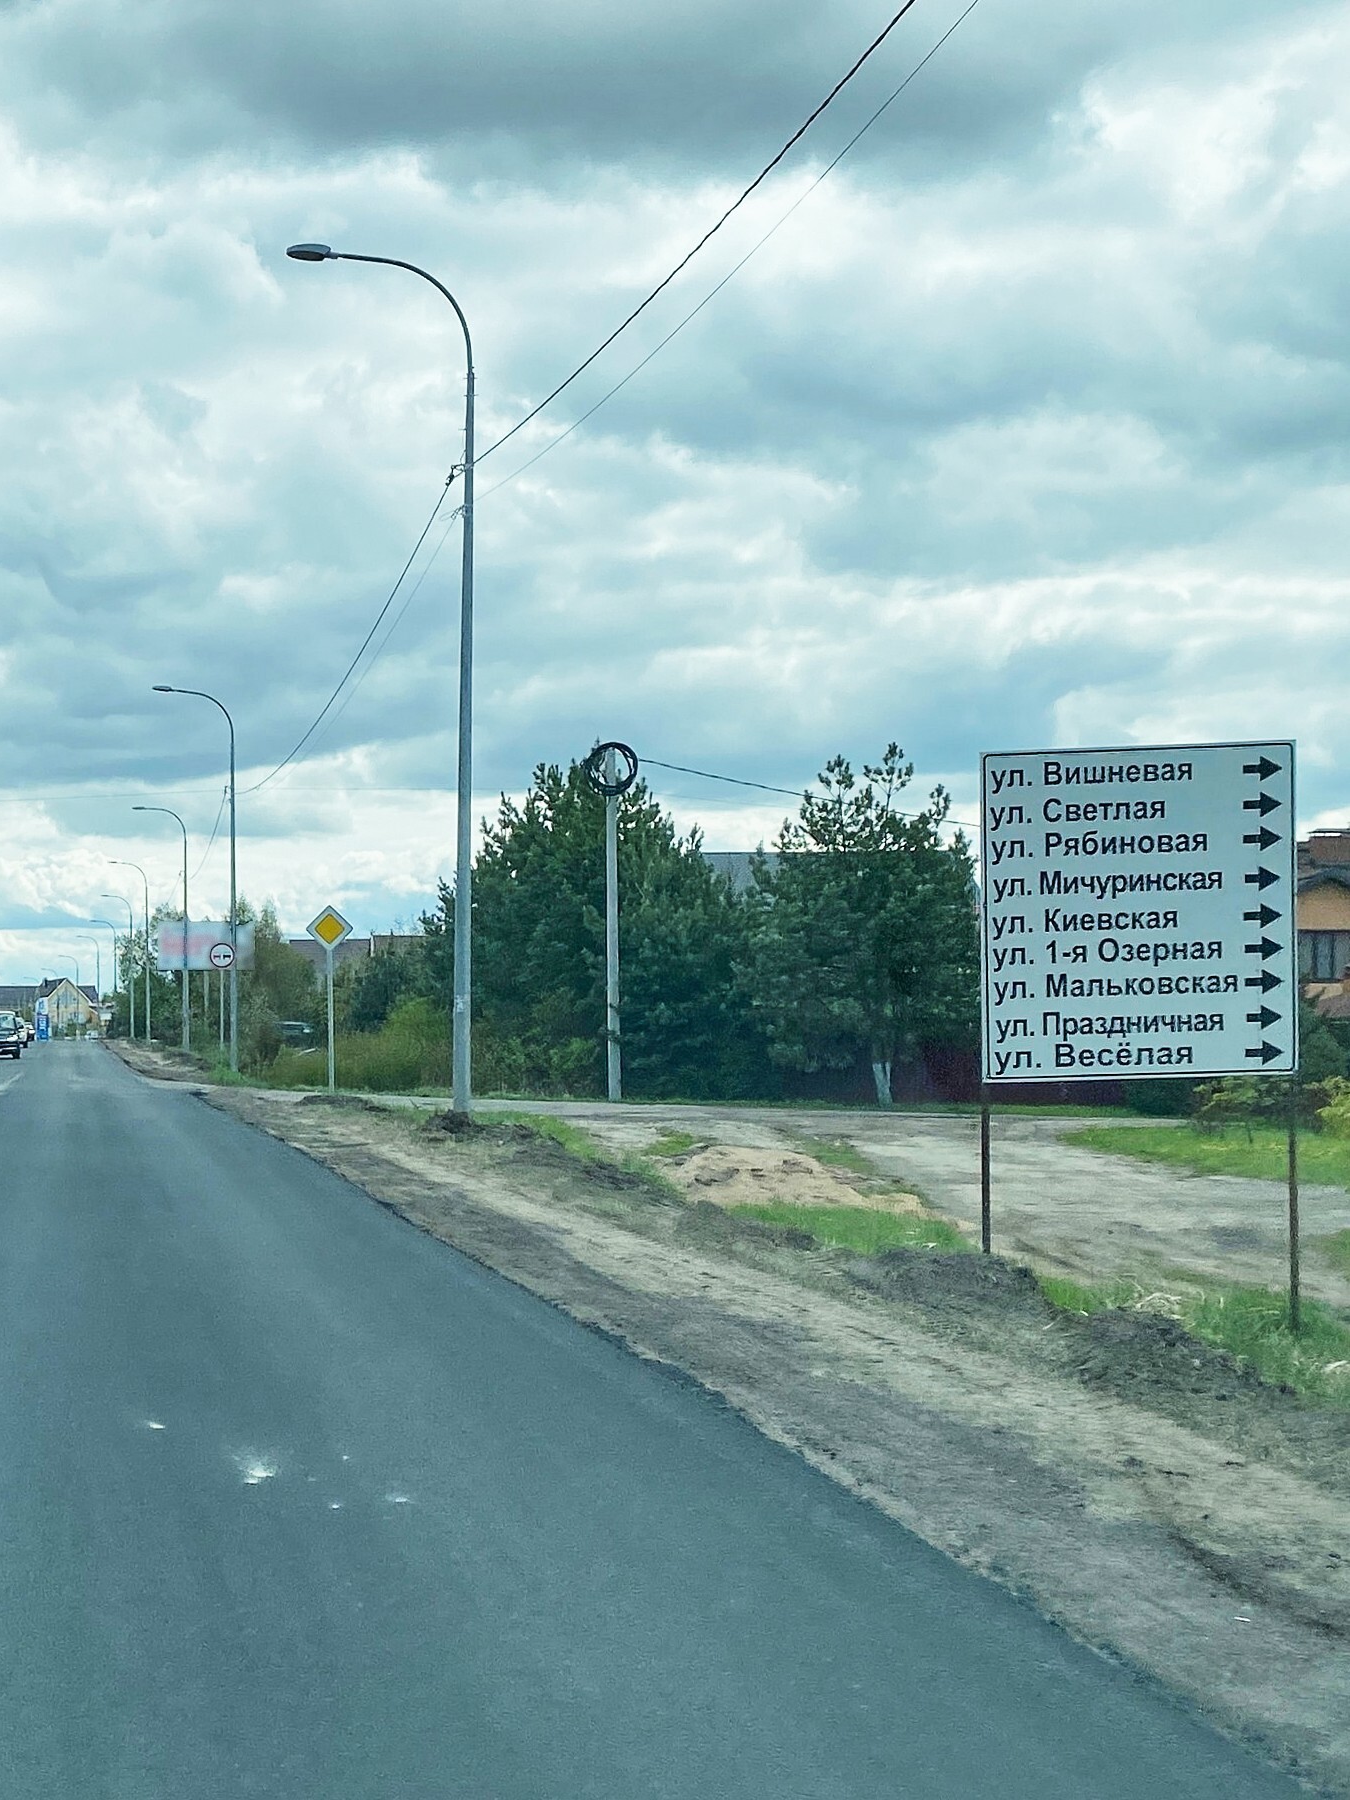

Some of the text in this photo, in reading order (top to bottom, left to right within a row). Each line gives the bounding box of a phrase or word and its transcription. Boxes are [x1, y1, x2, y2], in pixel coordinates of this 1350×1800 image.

[990, 761, 1193, 794] ул. Вишневая
[989, 798, 1166, 832] ул. Светлая
[991, 831, 1208, 866] ул. Рябиновая
[993, 870, 1223, 904] ул. Мичуринская
[992, 909, 1178, 941] ул. Киевская
[993, 938, 1223, 973] ул. 1-я Озерная
[994, 974, 1239, 1007] ул. Мальковская
[995, 1012, 1225, 1044] ул. Праздничная
[994, 1042, 1193, 1075] ул. Весёлая
